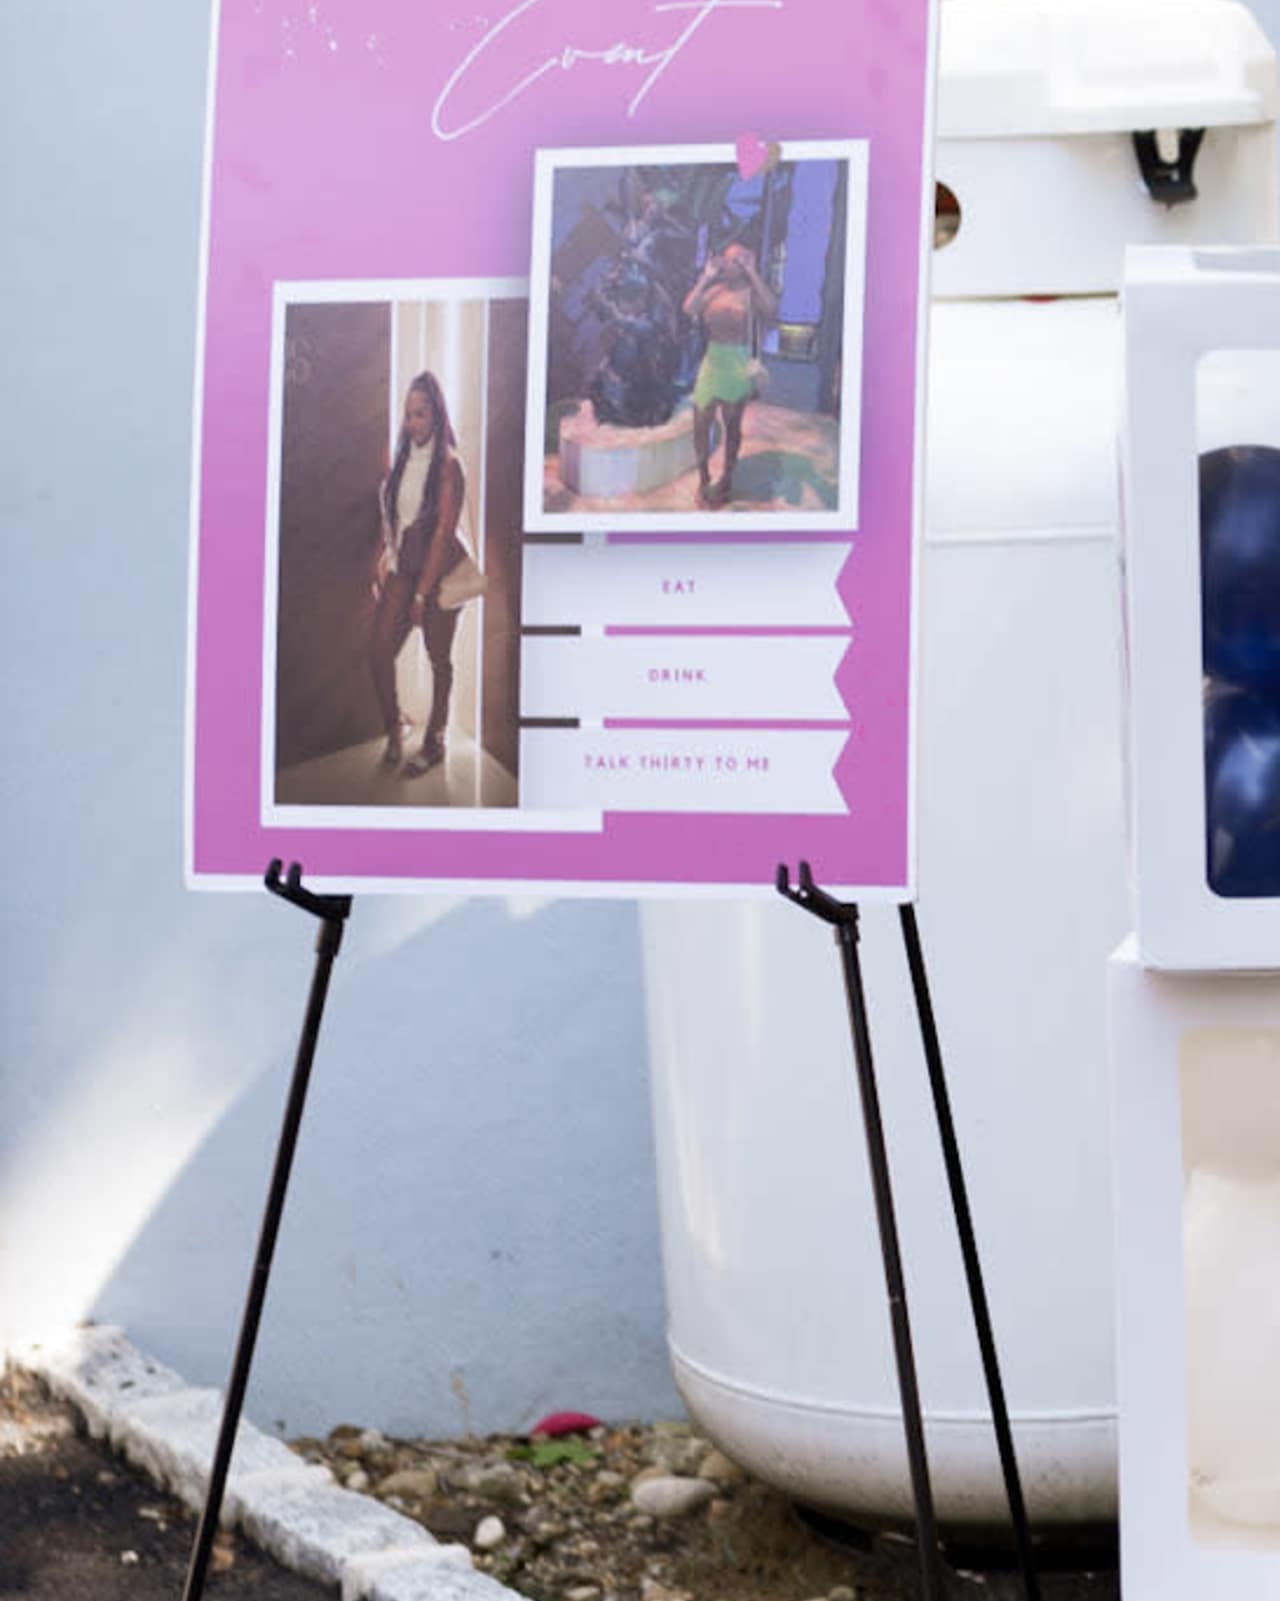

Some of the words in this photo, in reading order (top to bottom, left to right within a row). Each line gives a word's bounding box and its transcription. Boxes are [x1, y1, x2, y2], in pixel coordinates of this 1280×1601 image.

[661, 579, 697, 595] EAT
[647, 668, 706, 683] DRINK
[584, 754, 628, 770] TALK
[640, 755, 705, 771] THIRTY
[715, 756, 738, 771] TO
[746, 756, 770, 772] ME
